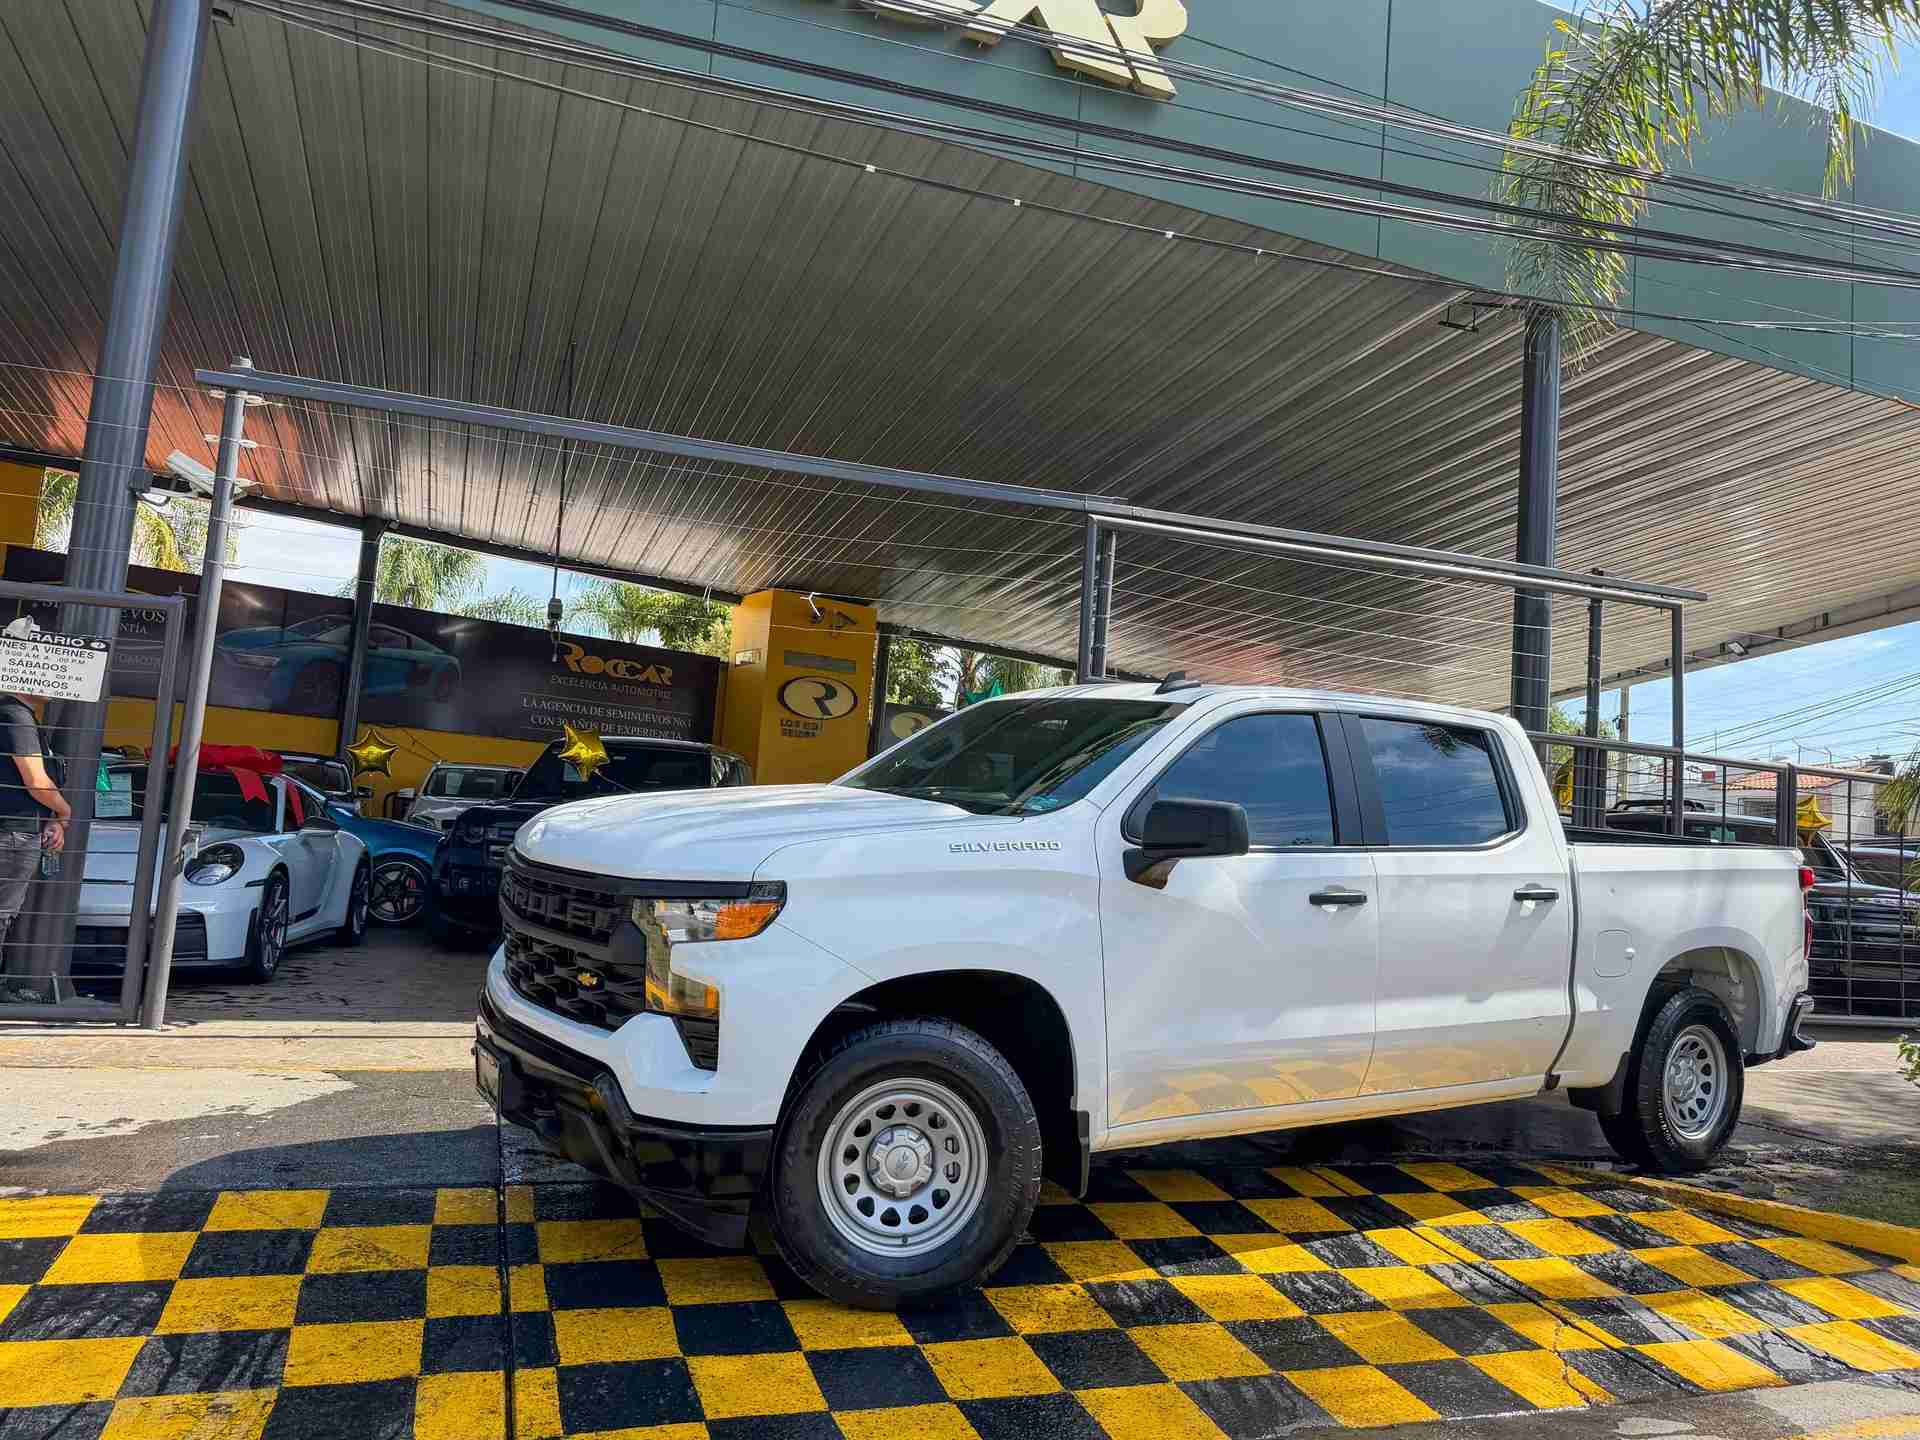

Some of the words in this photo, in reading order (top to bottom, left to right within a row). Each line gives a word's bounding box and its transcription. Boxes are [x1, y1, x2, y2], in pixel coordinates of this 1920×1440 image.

[2, 629, 84, 647] HRARIO
[44, 645, 95, 660] VIERNES
[1, 674, 69, 690] DOMINGOS
[551, 674, 608, 692] EXCELENCIA
[522, 695, 537, 709] LA
[537, 698, 589, 717] AGENCIA
[589, 706, 605, 718] DE
[606, 707, 672, 726] SEMINUEVOS
[530, 712, 556, 727] CON
[600, 721, 616, 733] DE
[616, 723, 683, 741] EXPERIENCIA
[948, 840, 1062, 853] SILVERADO
